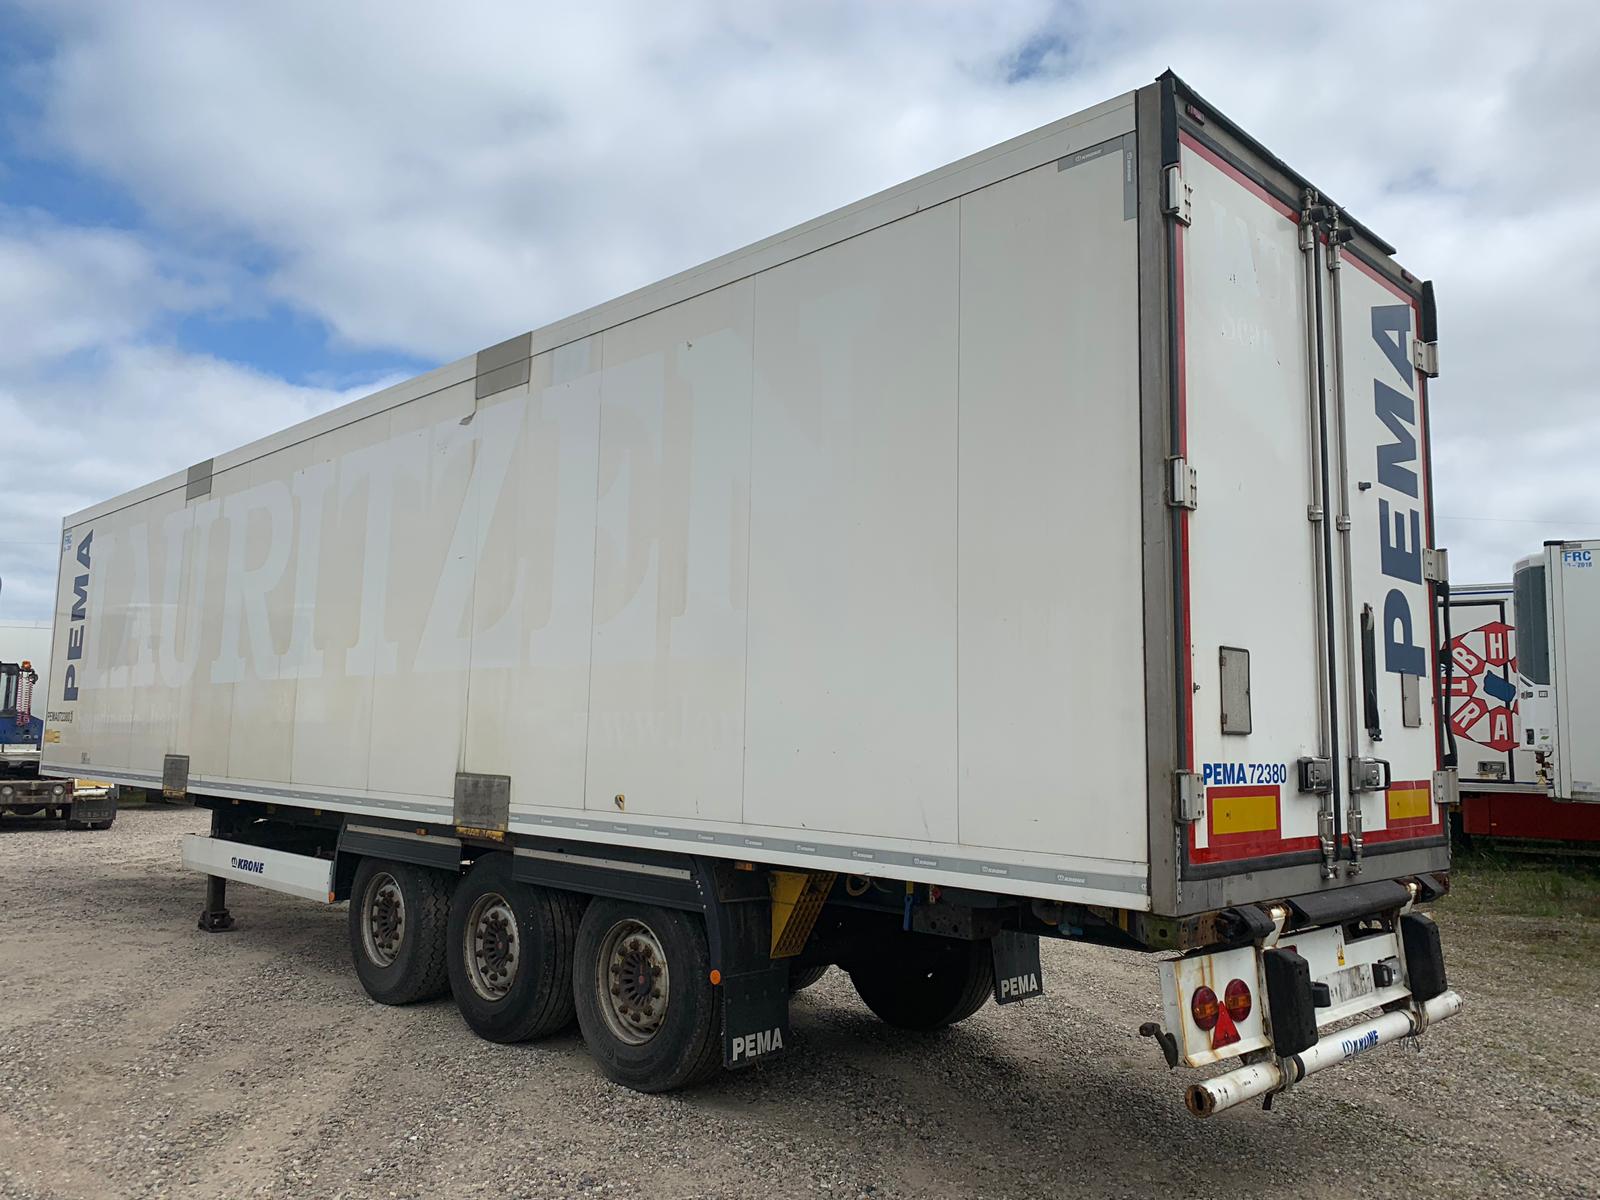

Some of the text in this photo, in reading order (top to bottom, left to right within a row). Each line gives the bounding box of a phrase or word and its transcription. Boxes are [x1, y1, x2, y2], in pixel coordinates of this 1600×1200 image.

[1370, 304, 1426, 677] PEMA
[1564, 550, 1592, 562] FRC
[63, 528, 94, 701] PEMA
[1202, 763, 1287, 785] PEMA 72380
[237, 858, 265, 874] KRONE
[1000, 973, 1039, 999] PEMA
[732, 1027, 783, 1062] PEMA
